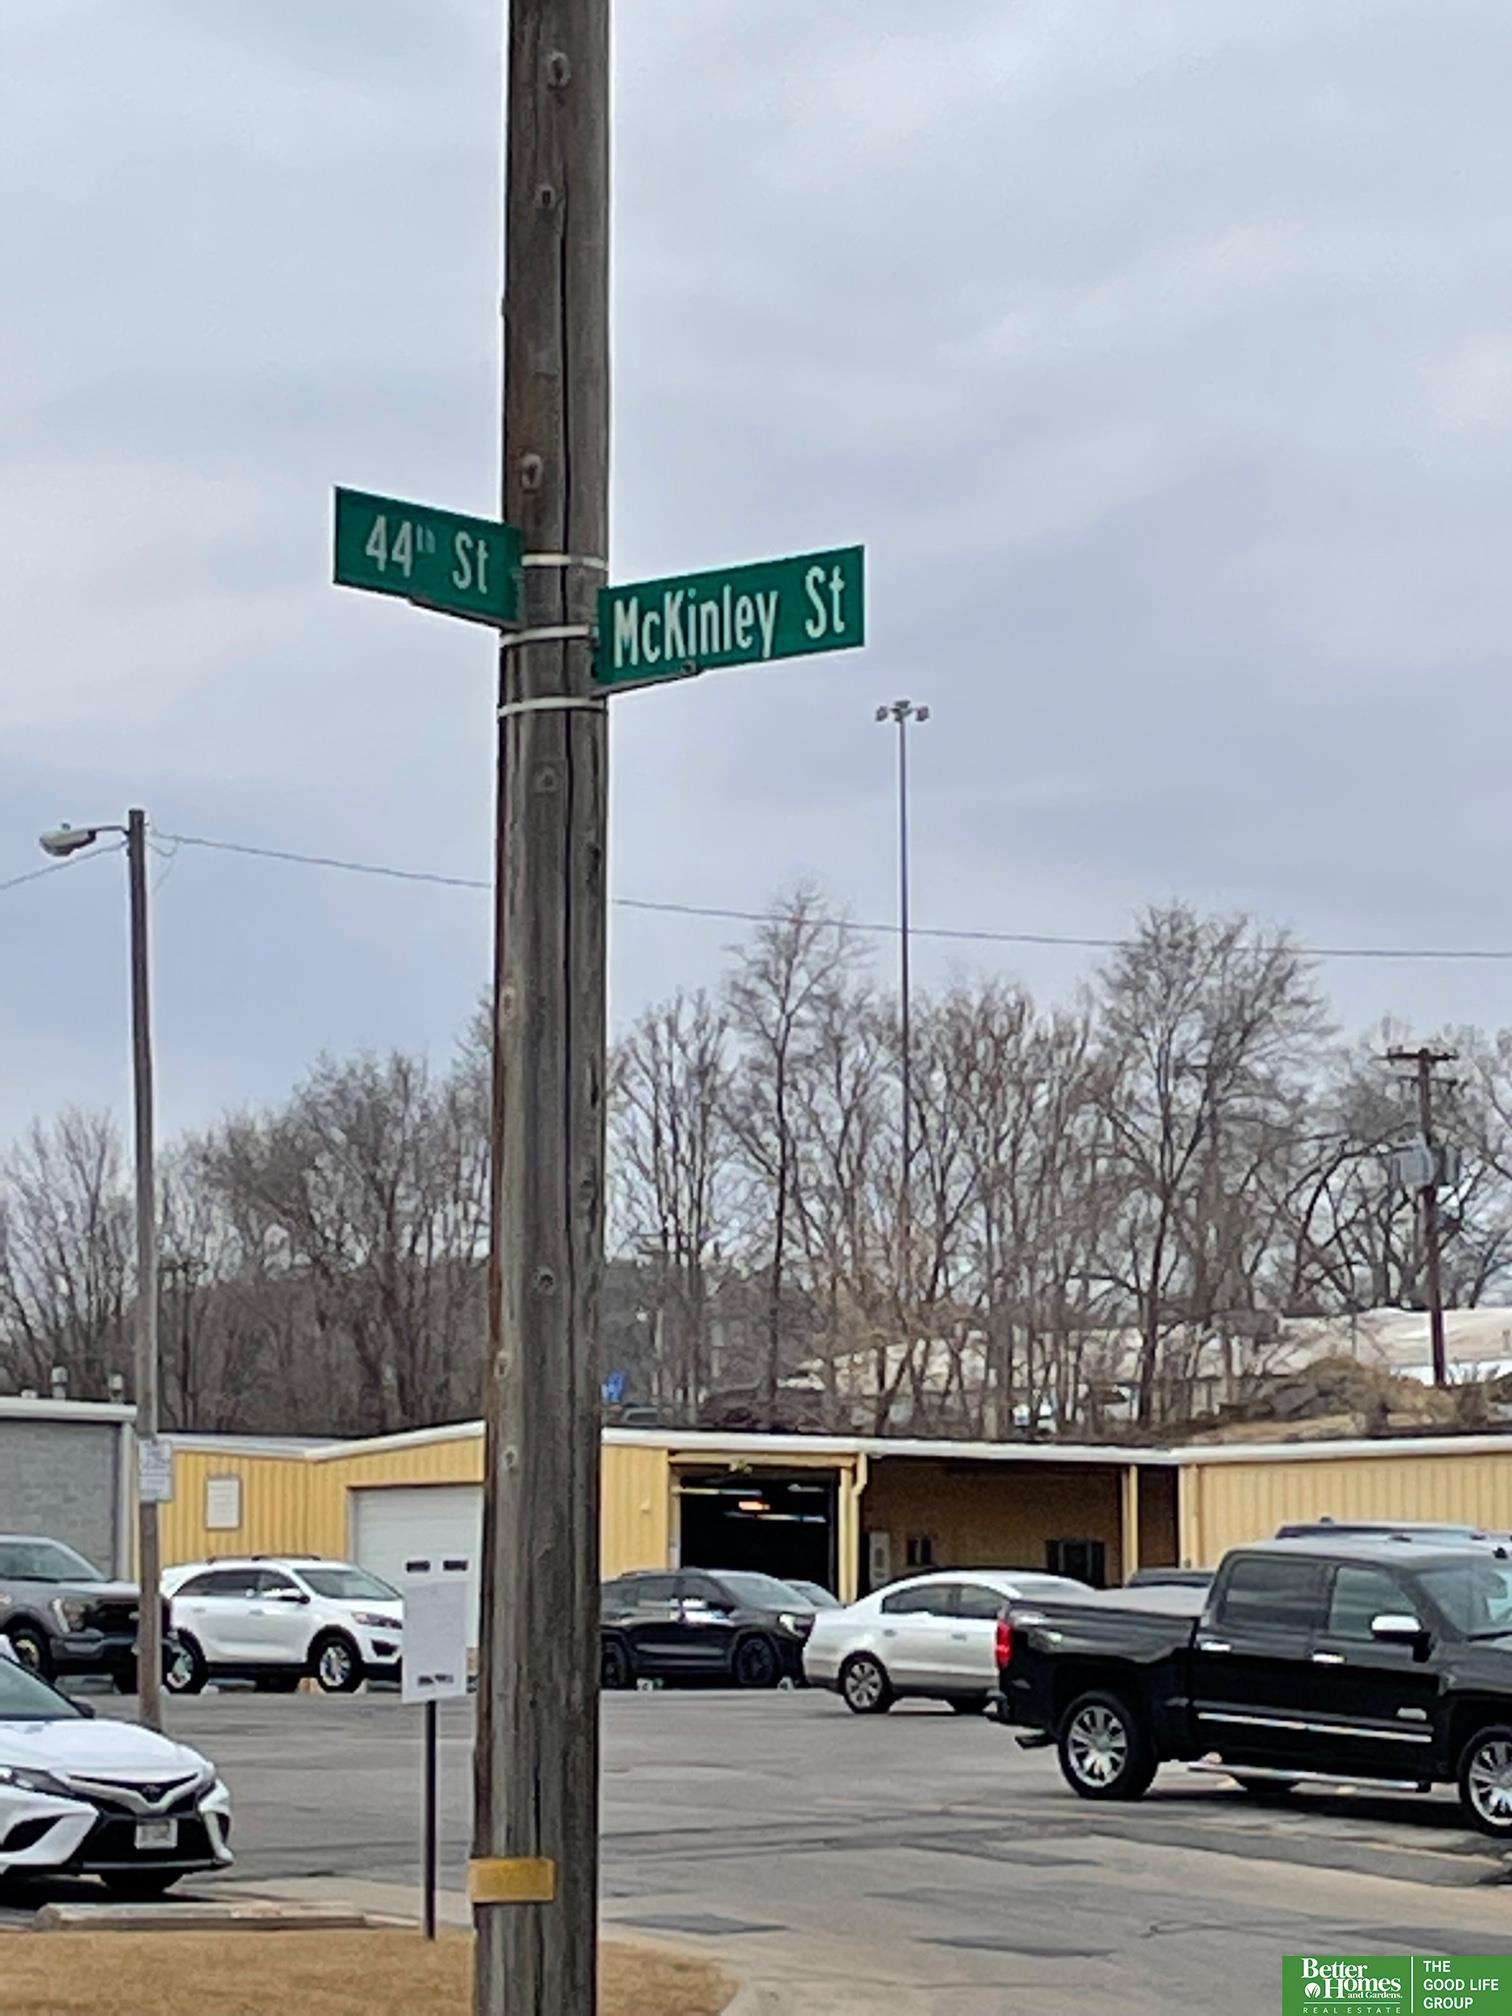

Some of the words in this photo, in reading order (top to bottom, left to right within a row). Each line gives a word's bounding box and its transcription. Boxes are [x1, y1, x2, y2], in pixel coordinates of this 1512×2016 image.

[365, 514, 436, 578] 44th
[452, 531, 489, 594] St
[613, 584, 779, 668] McKinley
[804, 565, 846, 639] St
